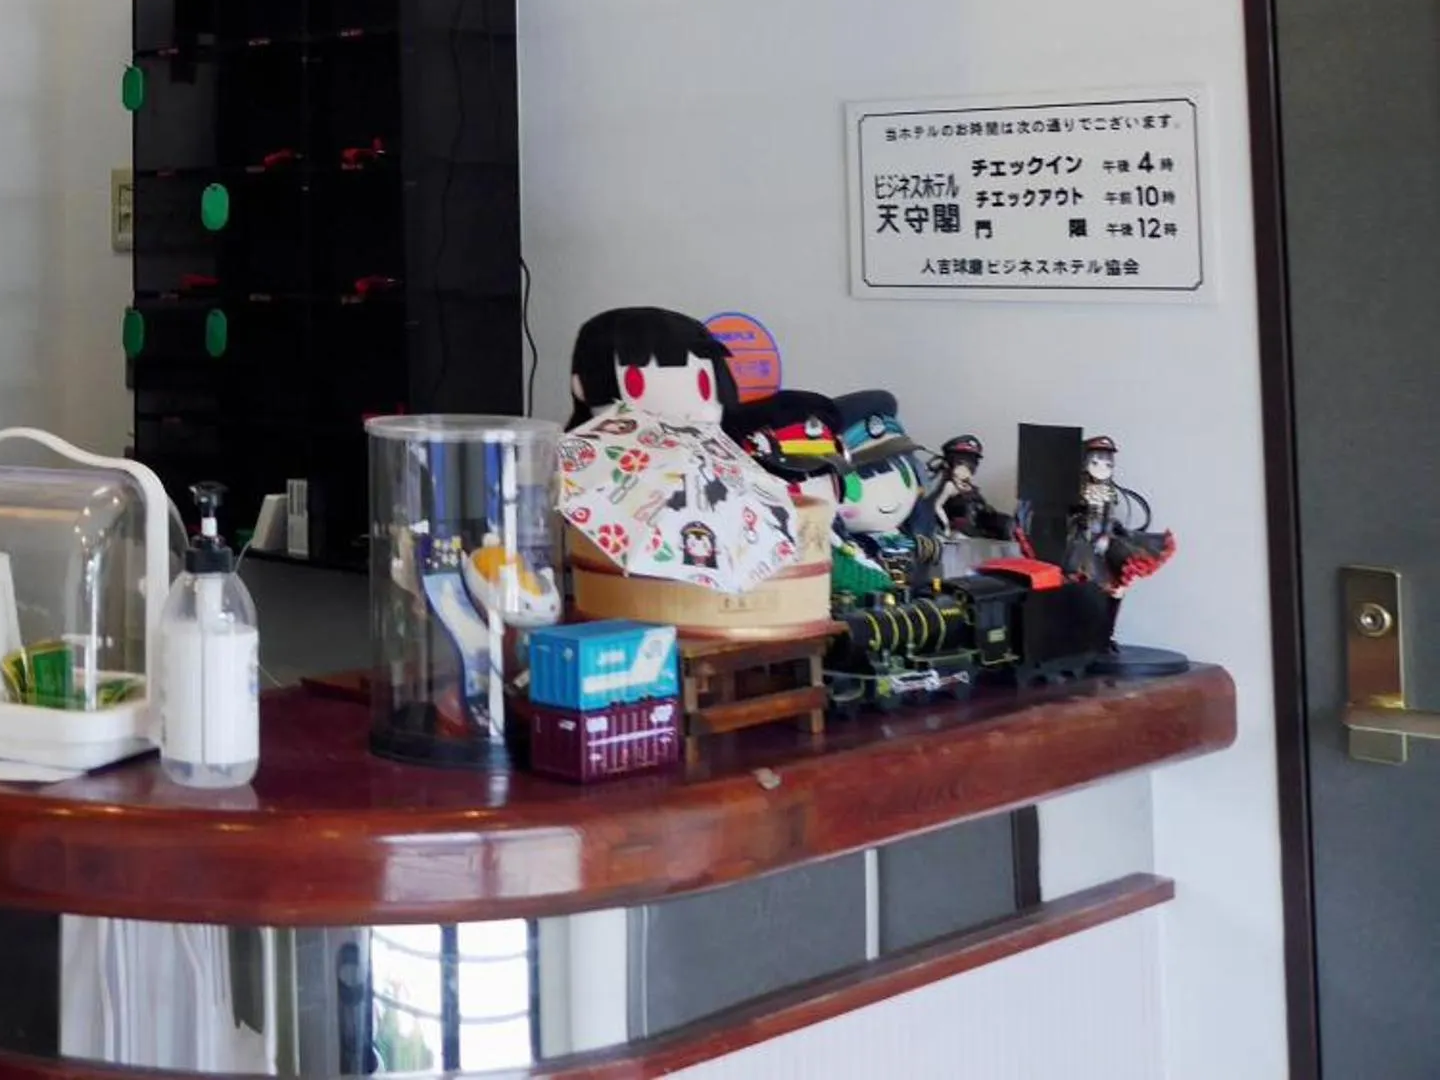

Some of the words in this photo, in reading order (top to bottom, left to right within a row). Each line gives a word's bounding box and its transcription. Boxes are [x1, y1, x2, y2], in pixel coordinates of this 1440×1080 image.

[874, 173, 959, 201] ビジネスホテル
[876, 203, 961, 234] 天守閣
